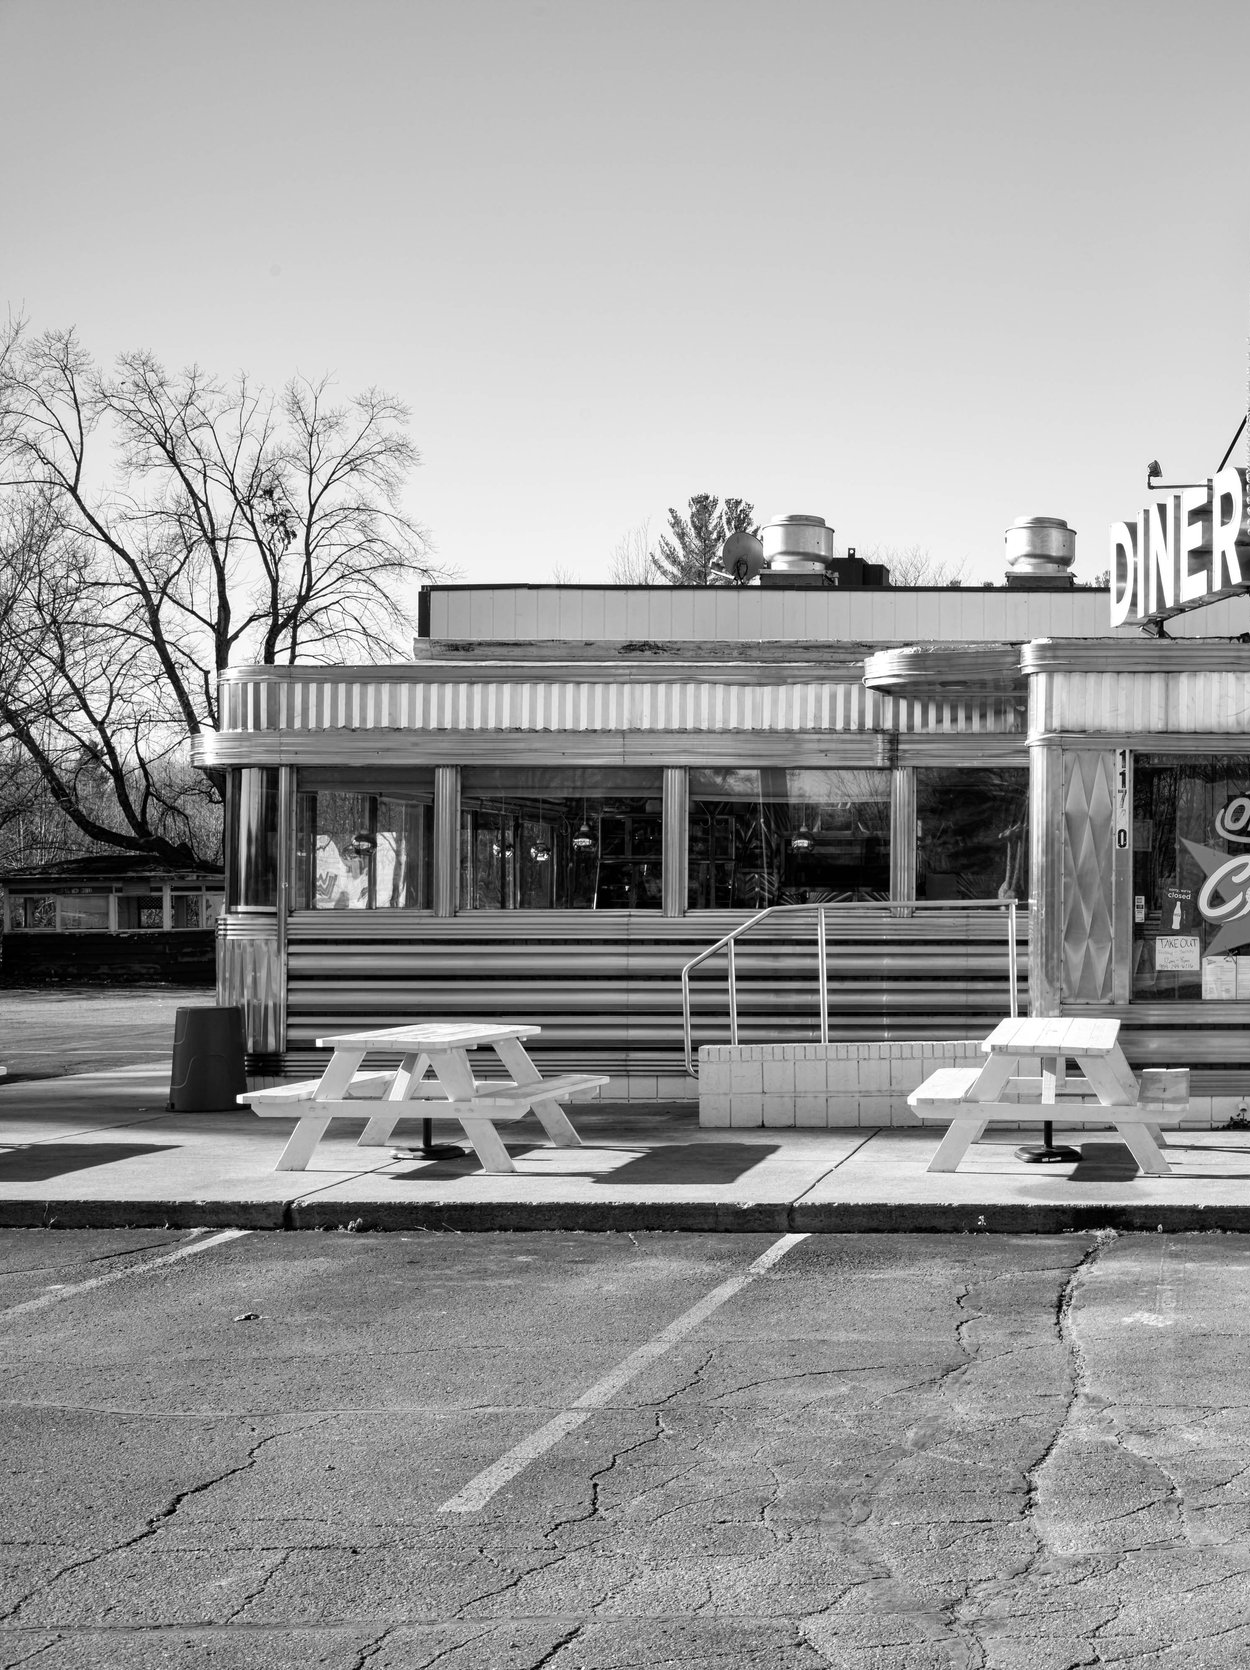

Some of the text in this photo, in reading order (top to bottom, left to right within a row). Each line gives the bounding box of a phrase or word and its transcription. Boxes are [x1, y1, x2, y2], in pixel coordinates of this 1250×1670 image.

[1109, 466, 1244, 628] DINER
[1167, 891, 1192, 900] closed
[1157, 938, 1198, 948] TAKE OUT
